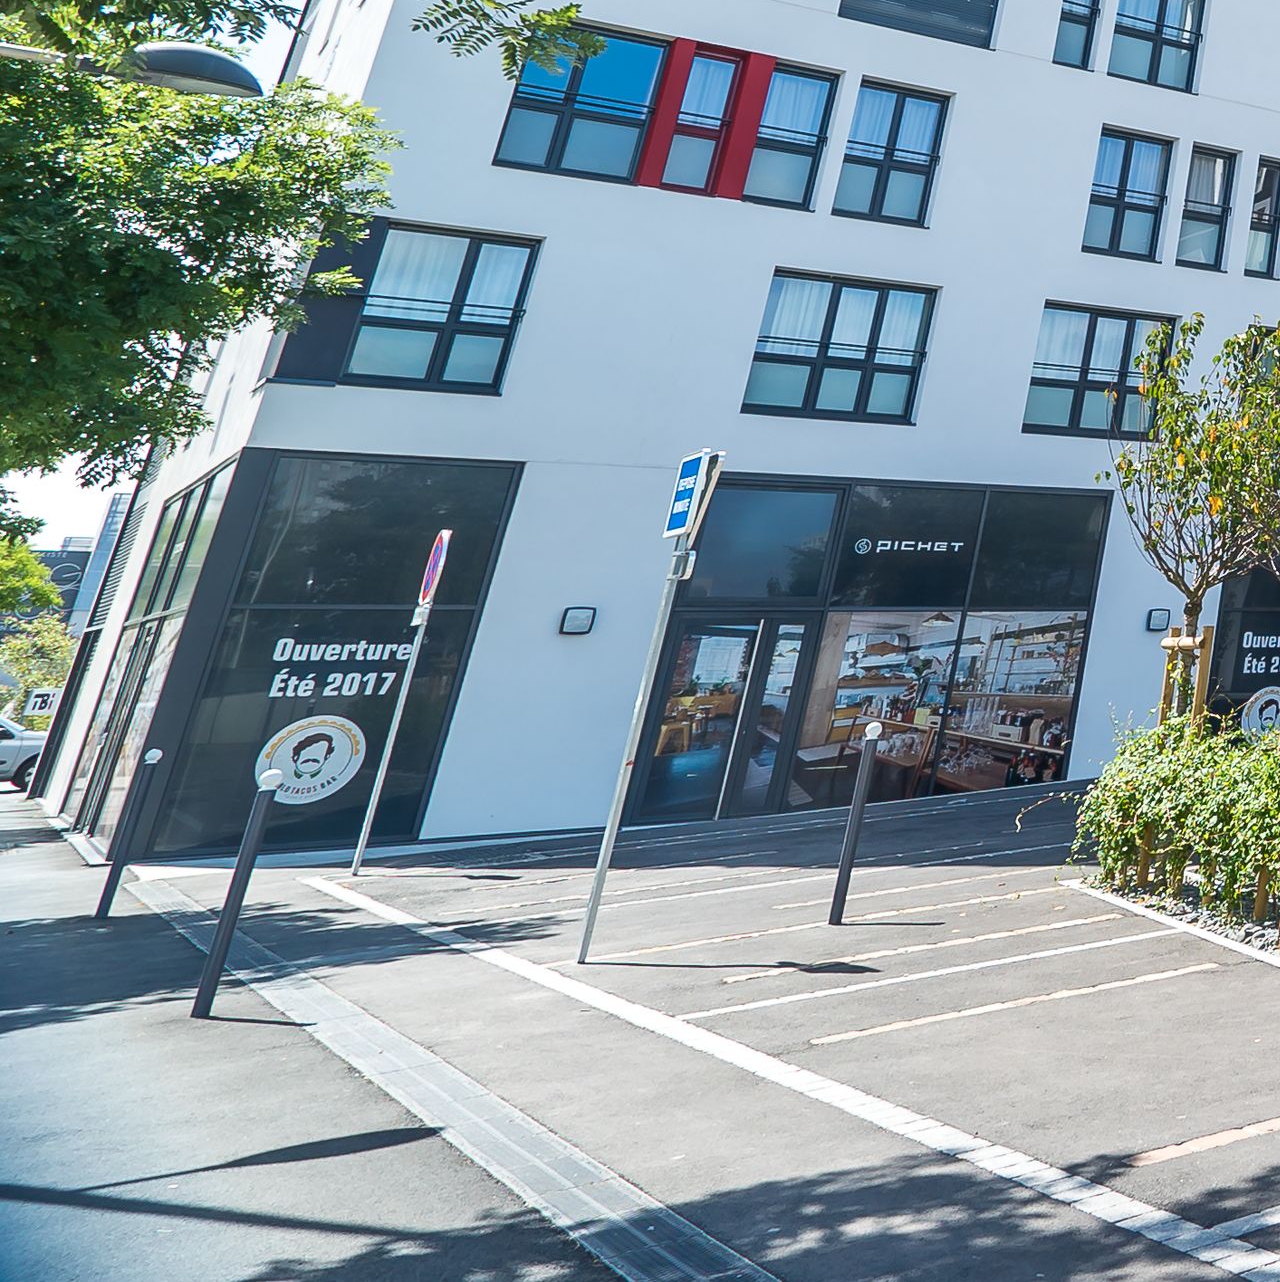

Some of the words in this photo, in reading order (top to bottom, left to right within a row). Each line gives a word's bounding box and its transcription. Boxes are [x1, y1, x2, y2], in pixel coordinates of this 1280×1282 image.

[272, 637, 413, 662] Ouverture
[1243, 652, 1266, 674] Été
[268, 668, 316, 698] Été
[322, 672, 396, 697] 2017
